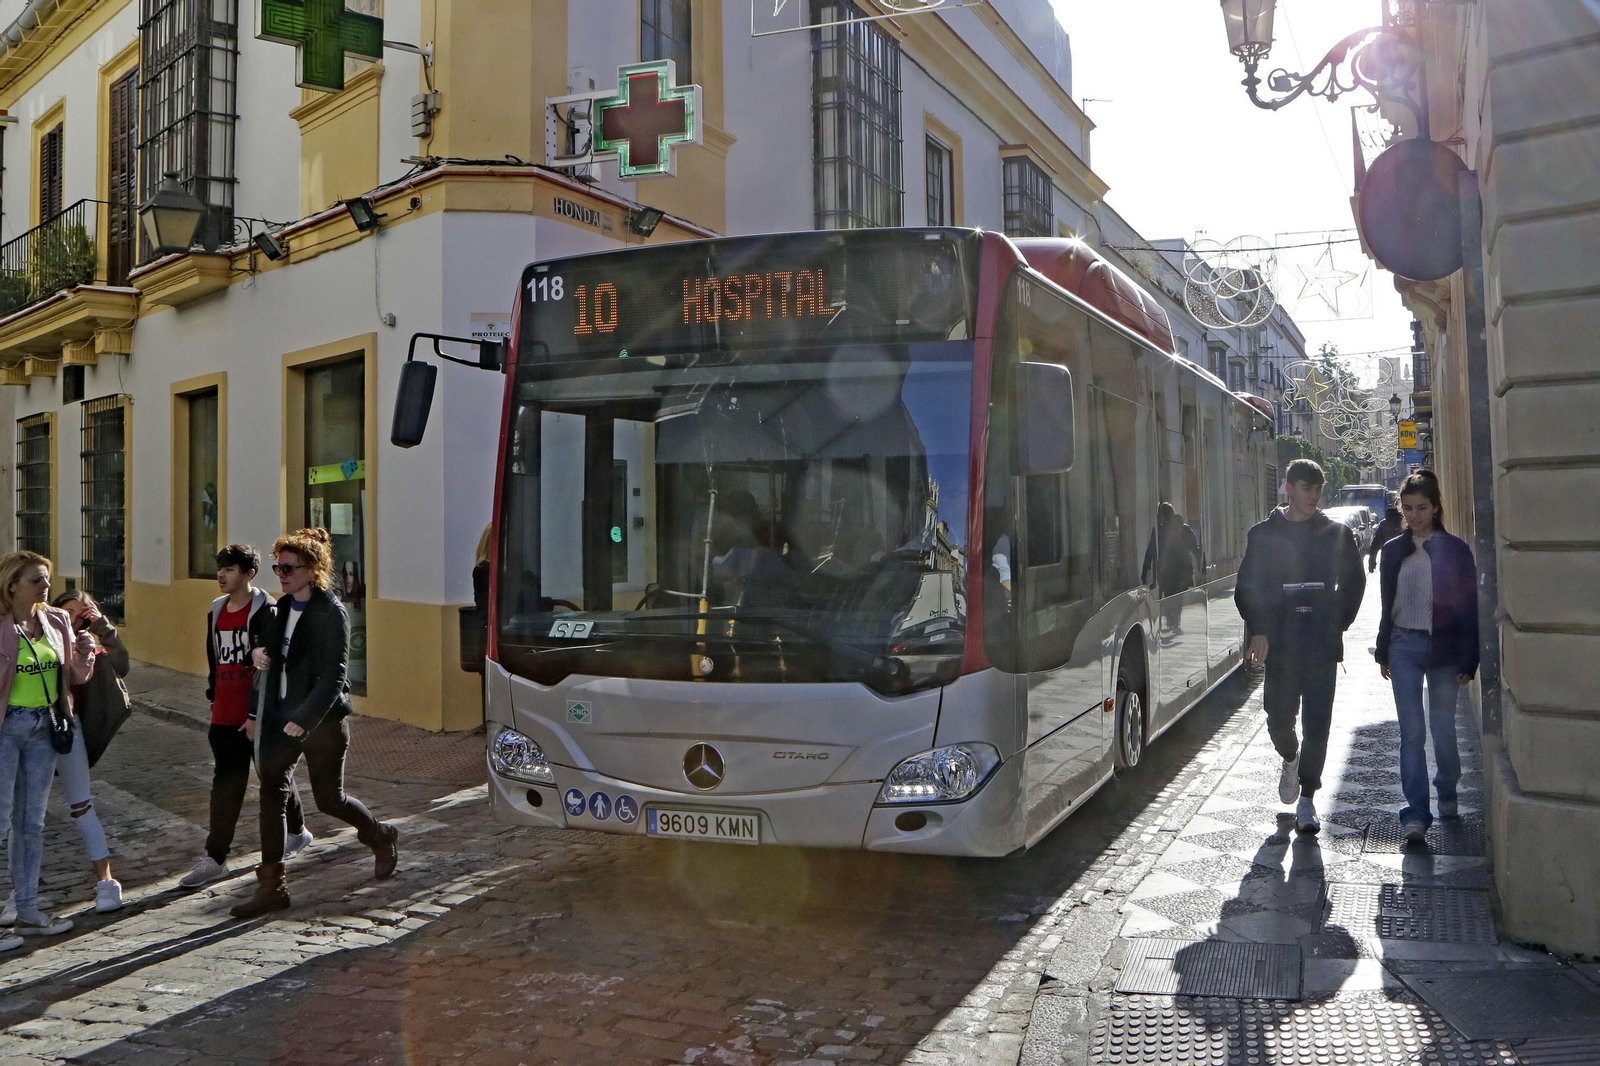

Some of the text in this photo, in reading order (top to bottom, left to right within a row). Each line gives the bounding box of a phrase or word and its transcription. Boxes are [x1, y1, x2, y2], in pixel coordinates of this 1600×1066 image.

[555, 198, 599, 227] HONDA
[526, 276, 564, 302] 118
[1017, 276, 1031, 307] 118
[573, 269, 835, 335] 10 HOSPITAL
[554, 622, 588, 638] SP
[16, 660, 60, 674] Rakute
[571, 708, 586, 716] CNG
[773, 751, 828, 760] CITARO
[660, 813, 753, 838] 9609 KMN
